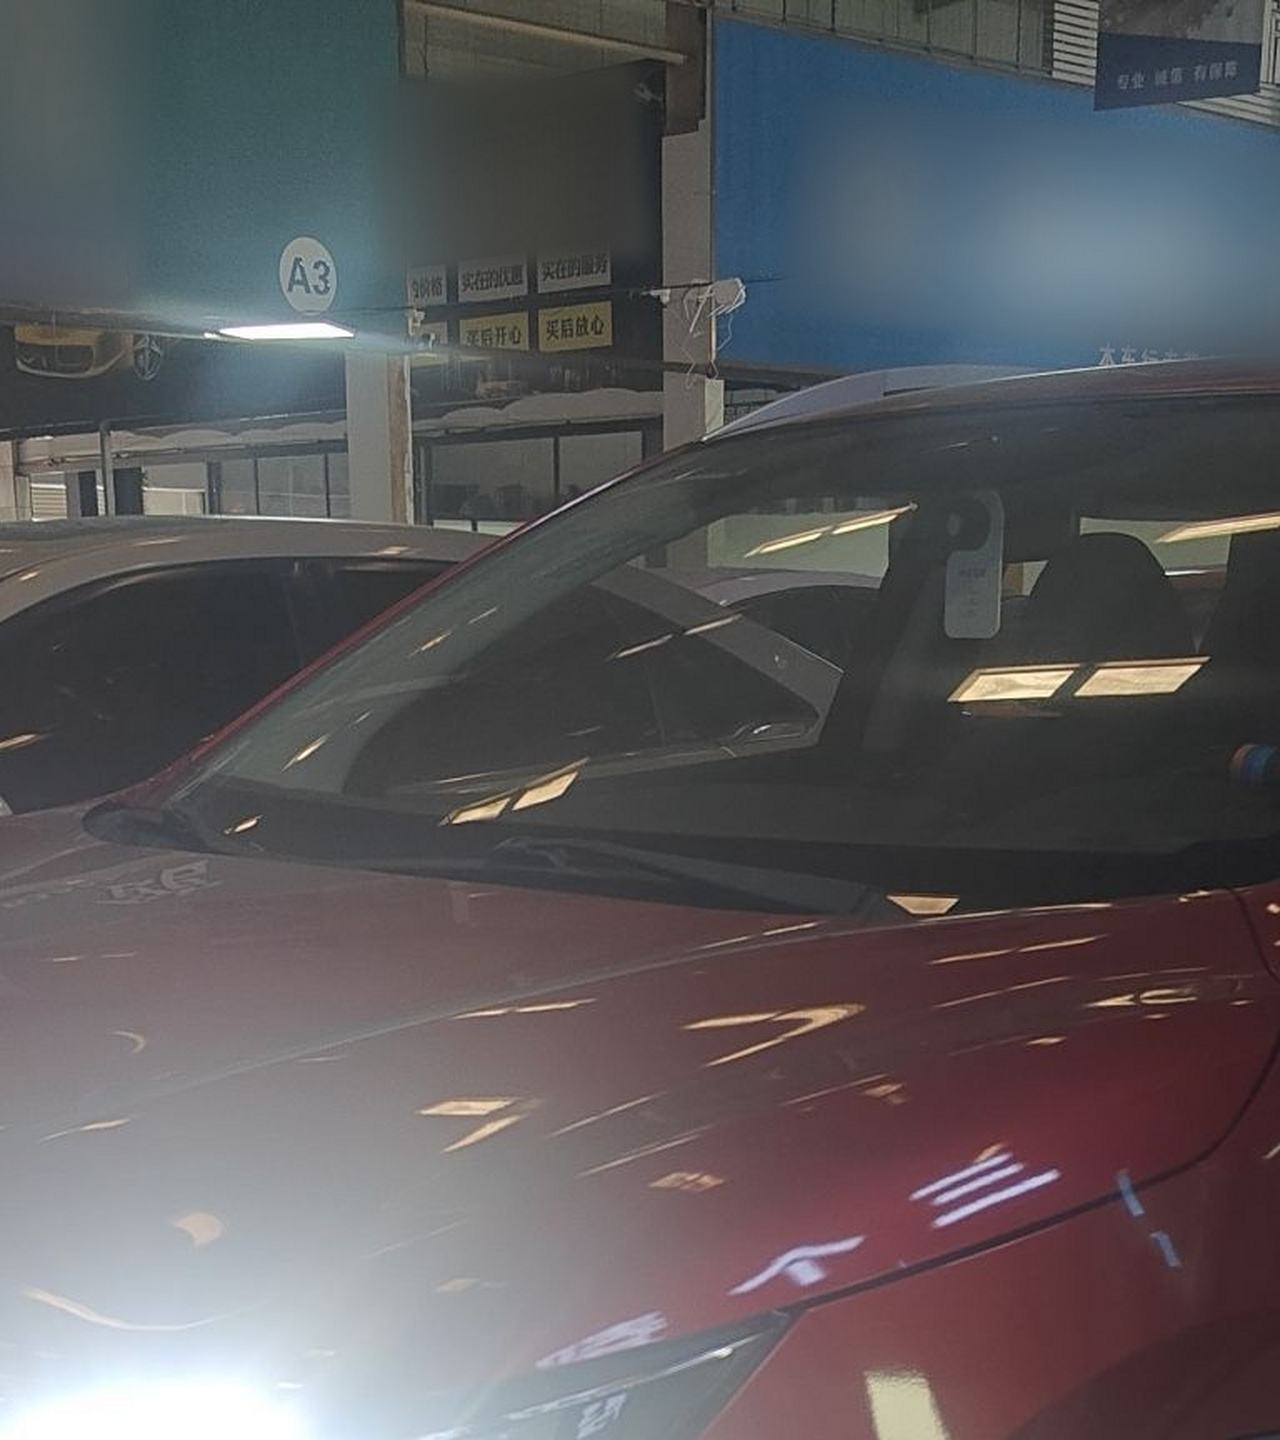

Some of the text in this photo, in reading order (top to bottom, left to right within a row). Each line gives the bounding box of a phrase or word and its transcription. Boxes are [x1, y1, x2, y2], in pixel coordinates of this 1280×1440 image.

[287, 256, 331, 295] A3
[466, 324, 521, 347] 买后开心
[546, 316, 605, 342] 买后放心
